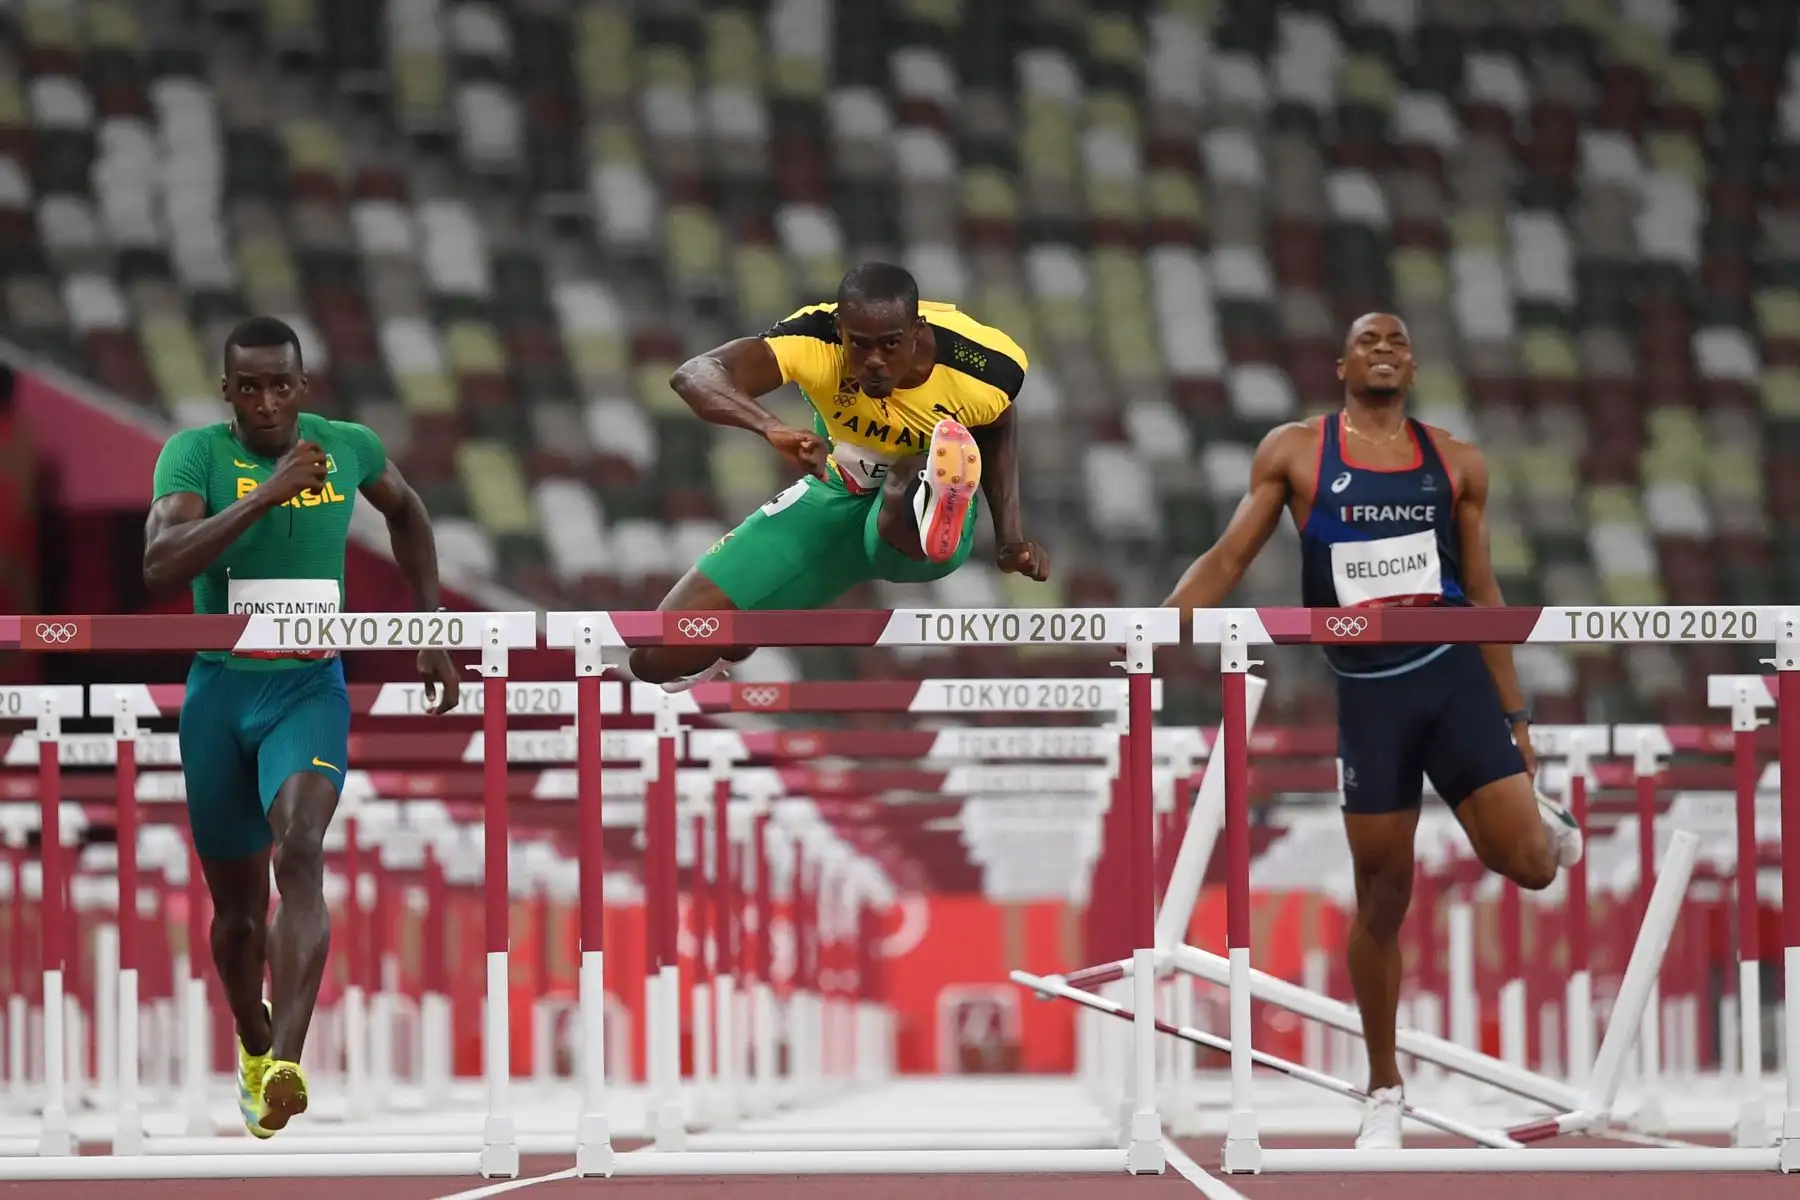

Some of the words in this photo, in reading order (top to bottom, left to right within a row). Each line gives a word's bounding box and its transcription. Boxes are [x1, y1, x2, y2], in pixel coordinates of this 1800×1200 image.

[236, 477, 345, 509] BSIL
[1352, 505, 1436, 522] FRANCE
[1346, 553, 1428, 579] BELOCIAN
[233, 602, 336, 614] CONSTANTINO
[273, 617, 378, 646] TOKYO
[387, 617, 465, 646] 2020
[915, 613, 1021, 642] TOKYO
[1029, 613, 1107, 642] 2020
[1565, 611, 1671, 639] TOKYO
[1680, 611, 1759, 639] 2020
[942, 684, 1030, 707] TOKYO
[1037, 684, 1102, 707] 2020
